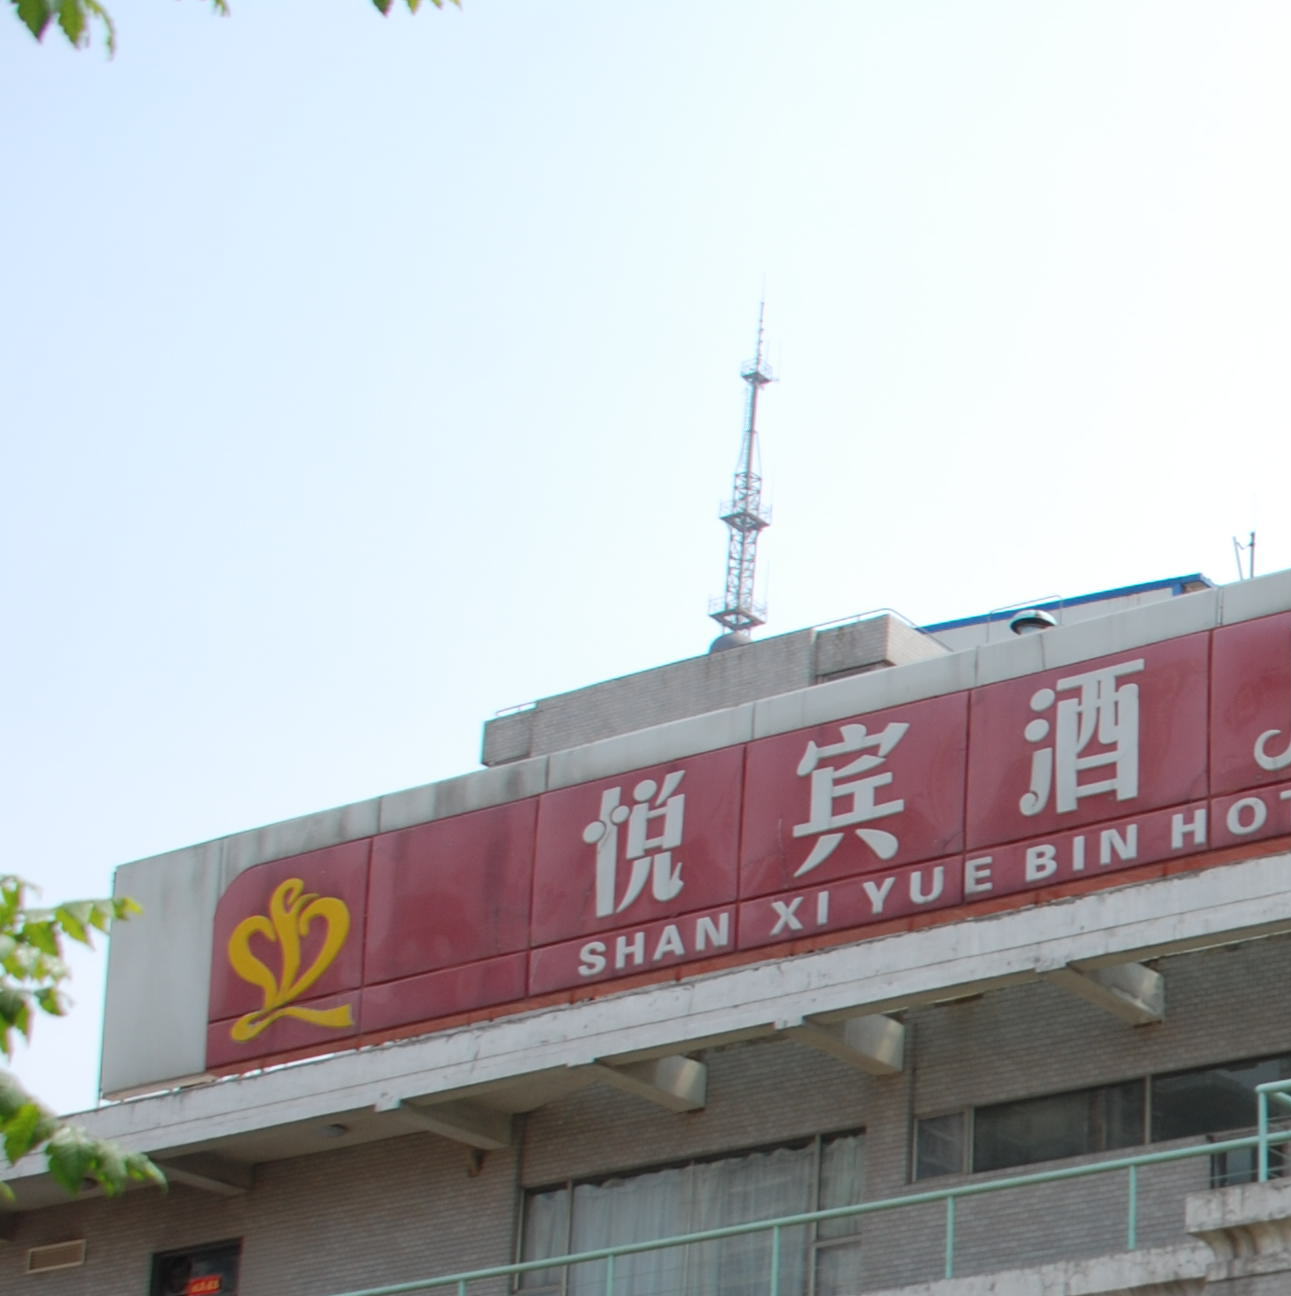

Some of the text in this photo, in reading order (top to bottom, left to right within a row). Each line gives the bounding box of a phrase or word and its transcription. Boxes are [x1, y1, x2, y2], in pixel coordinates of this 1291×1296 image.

[578, 911, 732, 978] SHAN
[771, 889, 831, 937] XI
[861, 856, 994, 915] YUE
[1025, 823, 1139, 884] BIN
